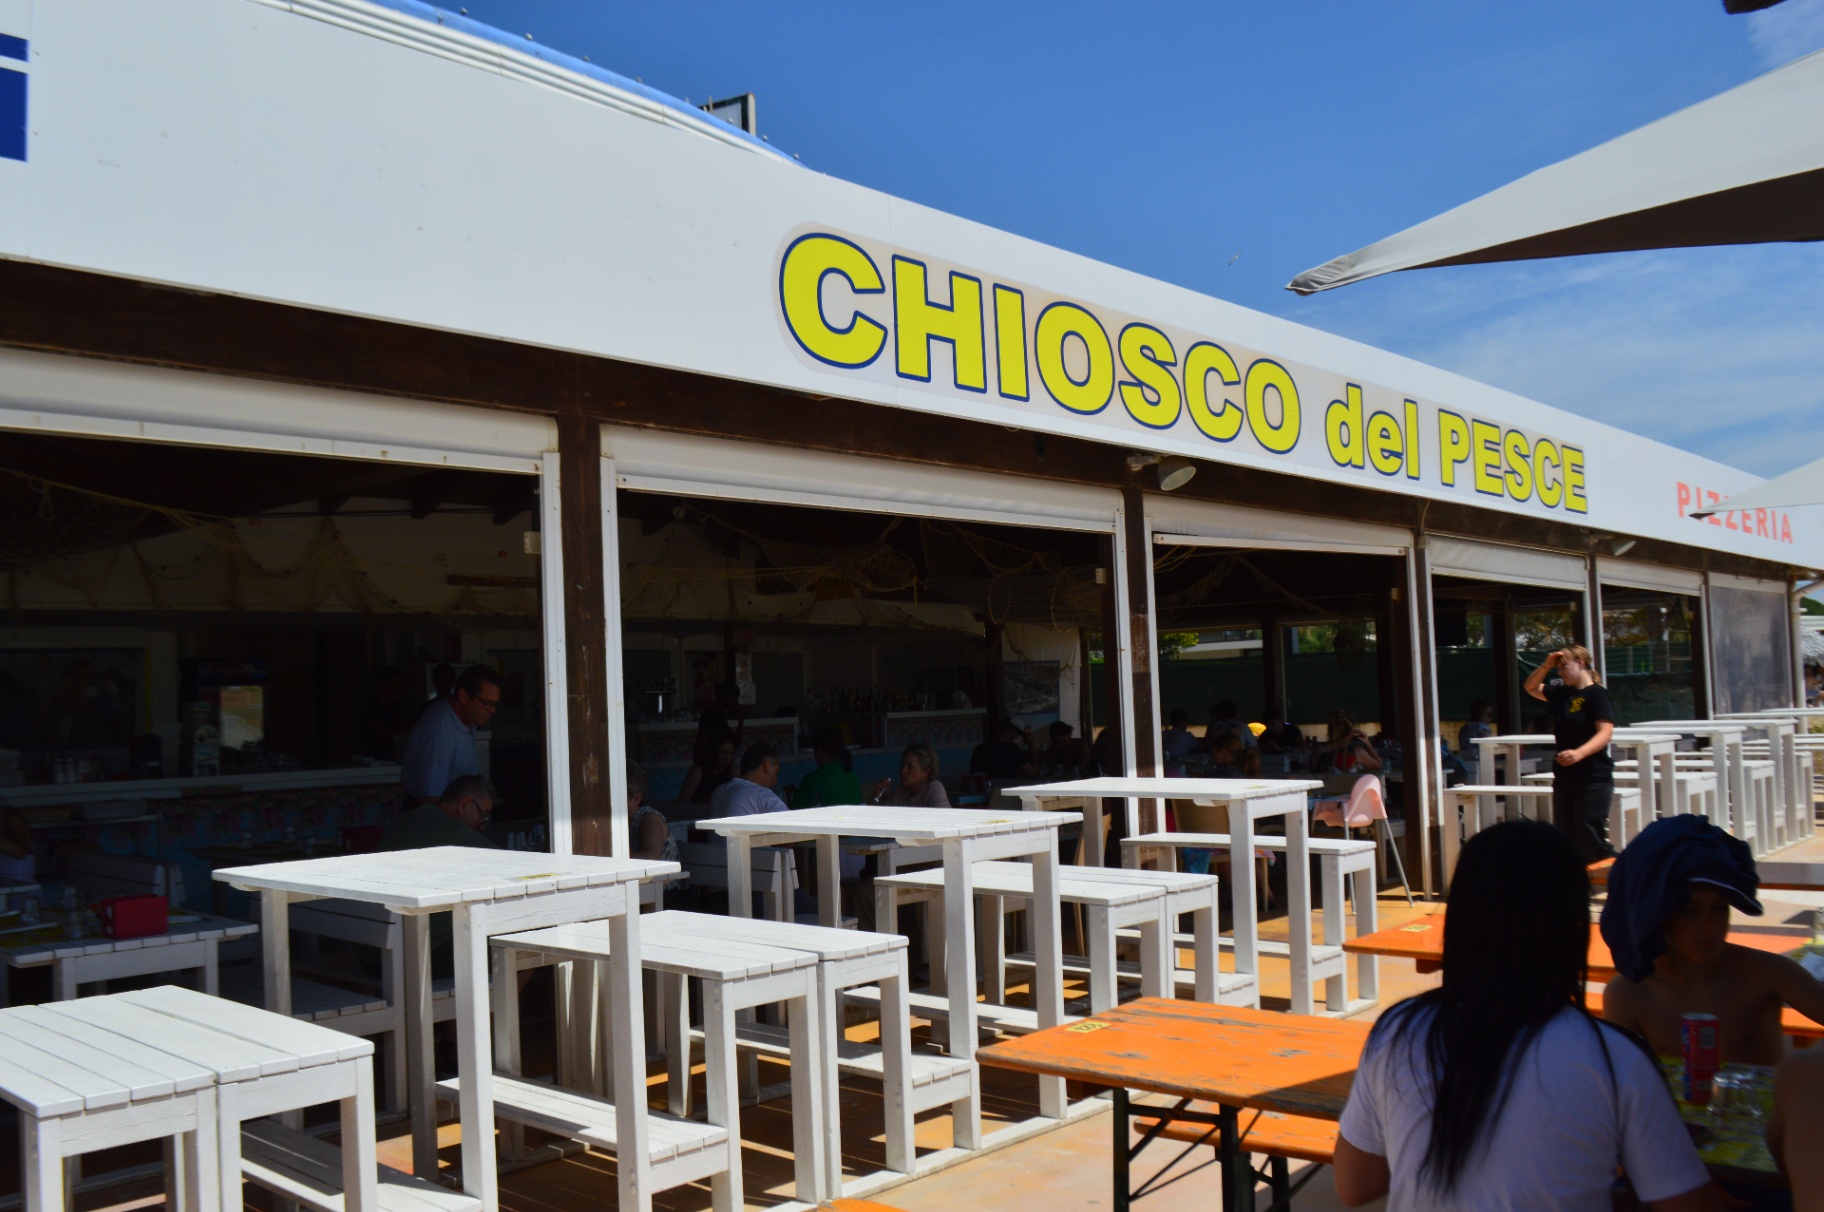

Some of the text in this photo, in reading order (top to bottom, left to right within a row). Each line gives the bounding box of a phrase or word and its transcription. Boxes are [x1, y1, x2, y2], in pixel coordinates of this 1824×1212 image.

[779, 232, 1301, 454] CHIOSCO
[1324, 382, 1421, 481] del
[1438, 408, 1588, 515] PESCE
